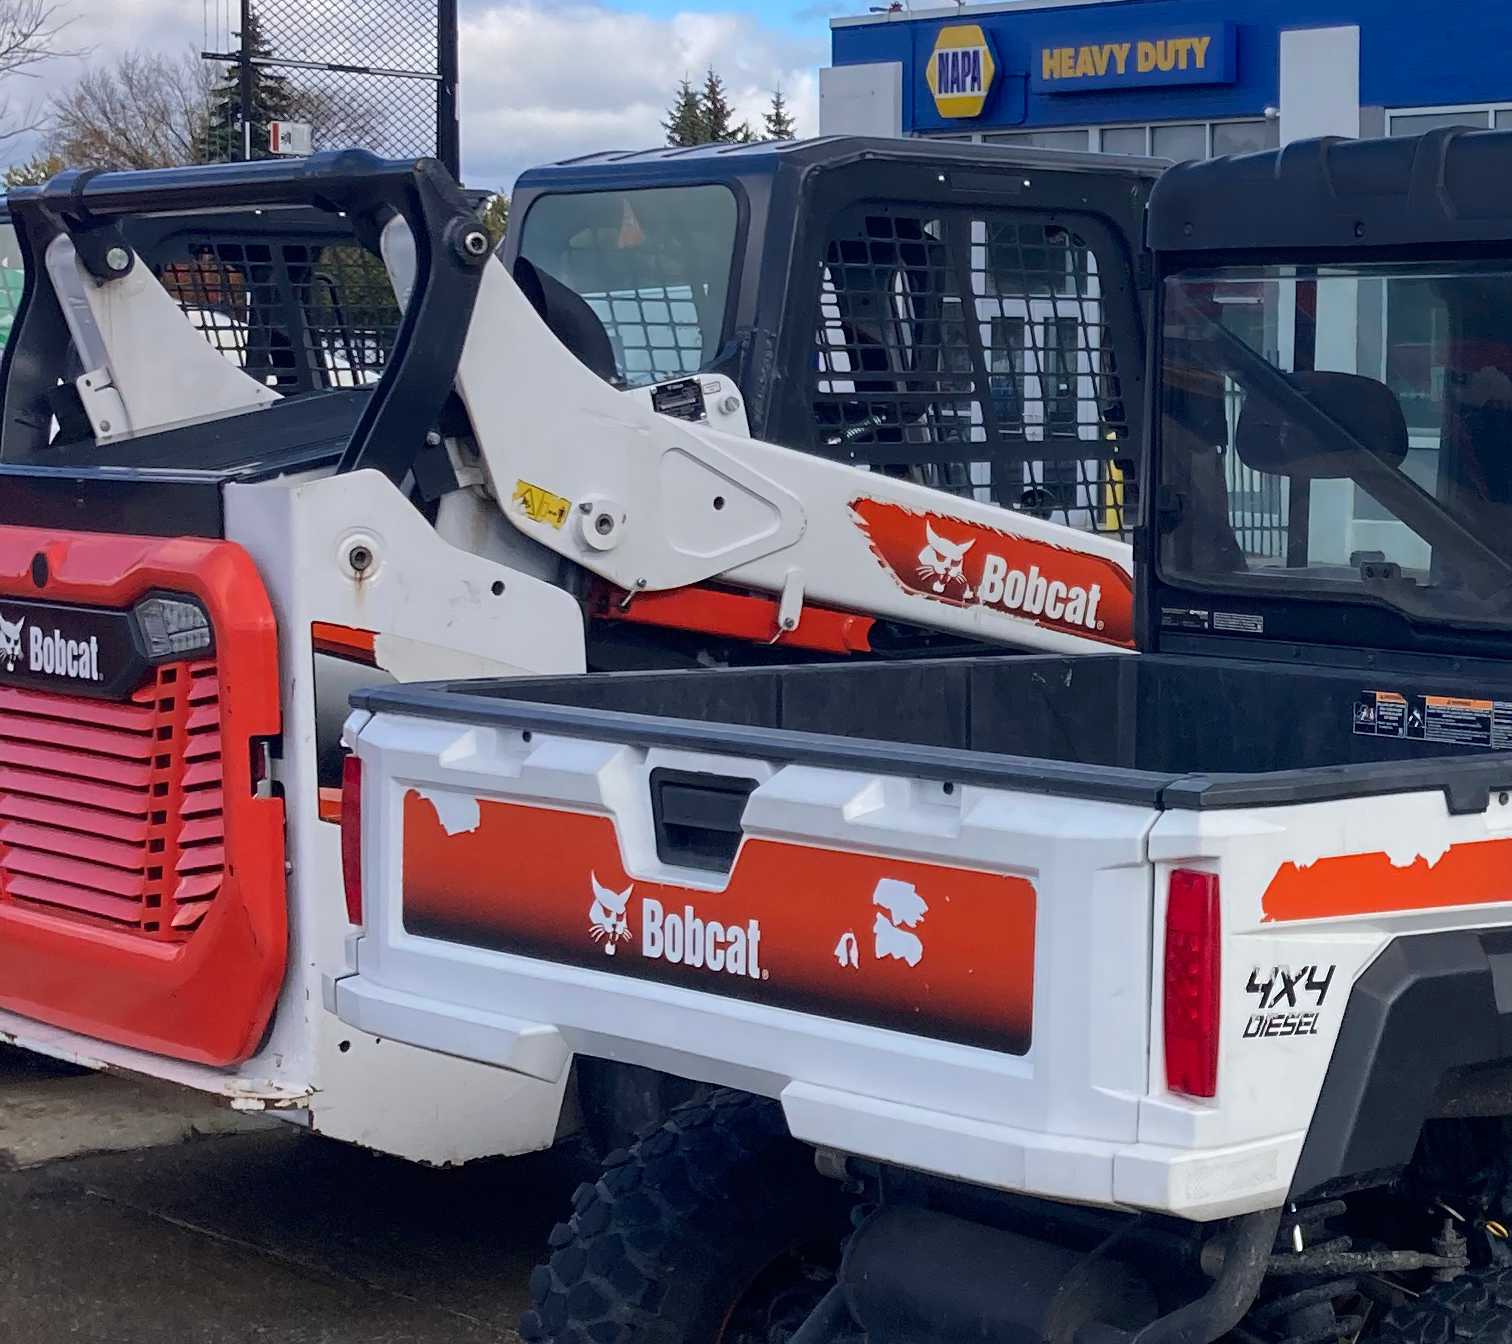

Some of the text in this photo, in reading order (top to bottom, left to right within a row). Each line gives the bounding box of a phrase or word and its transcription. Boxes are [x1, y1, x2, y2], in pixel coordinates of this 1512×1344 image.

[937, 49, 982, 95] NAPA
[1041, 36, 1211, 81] HEAVY DUTY
[978, 553, 1102, 629] Bobcat
[29, 626, 99, 681] Bobcat
[642, 897, 761, 980] Bobcat
[1242, 1012, 1320, 1039] DIESEL
